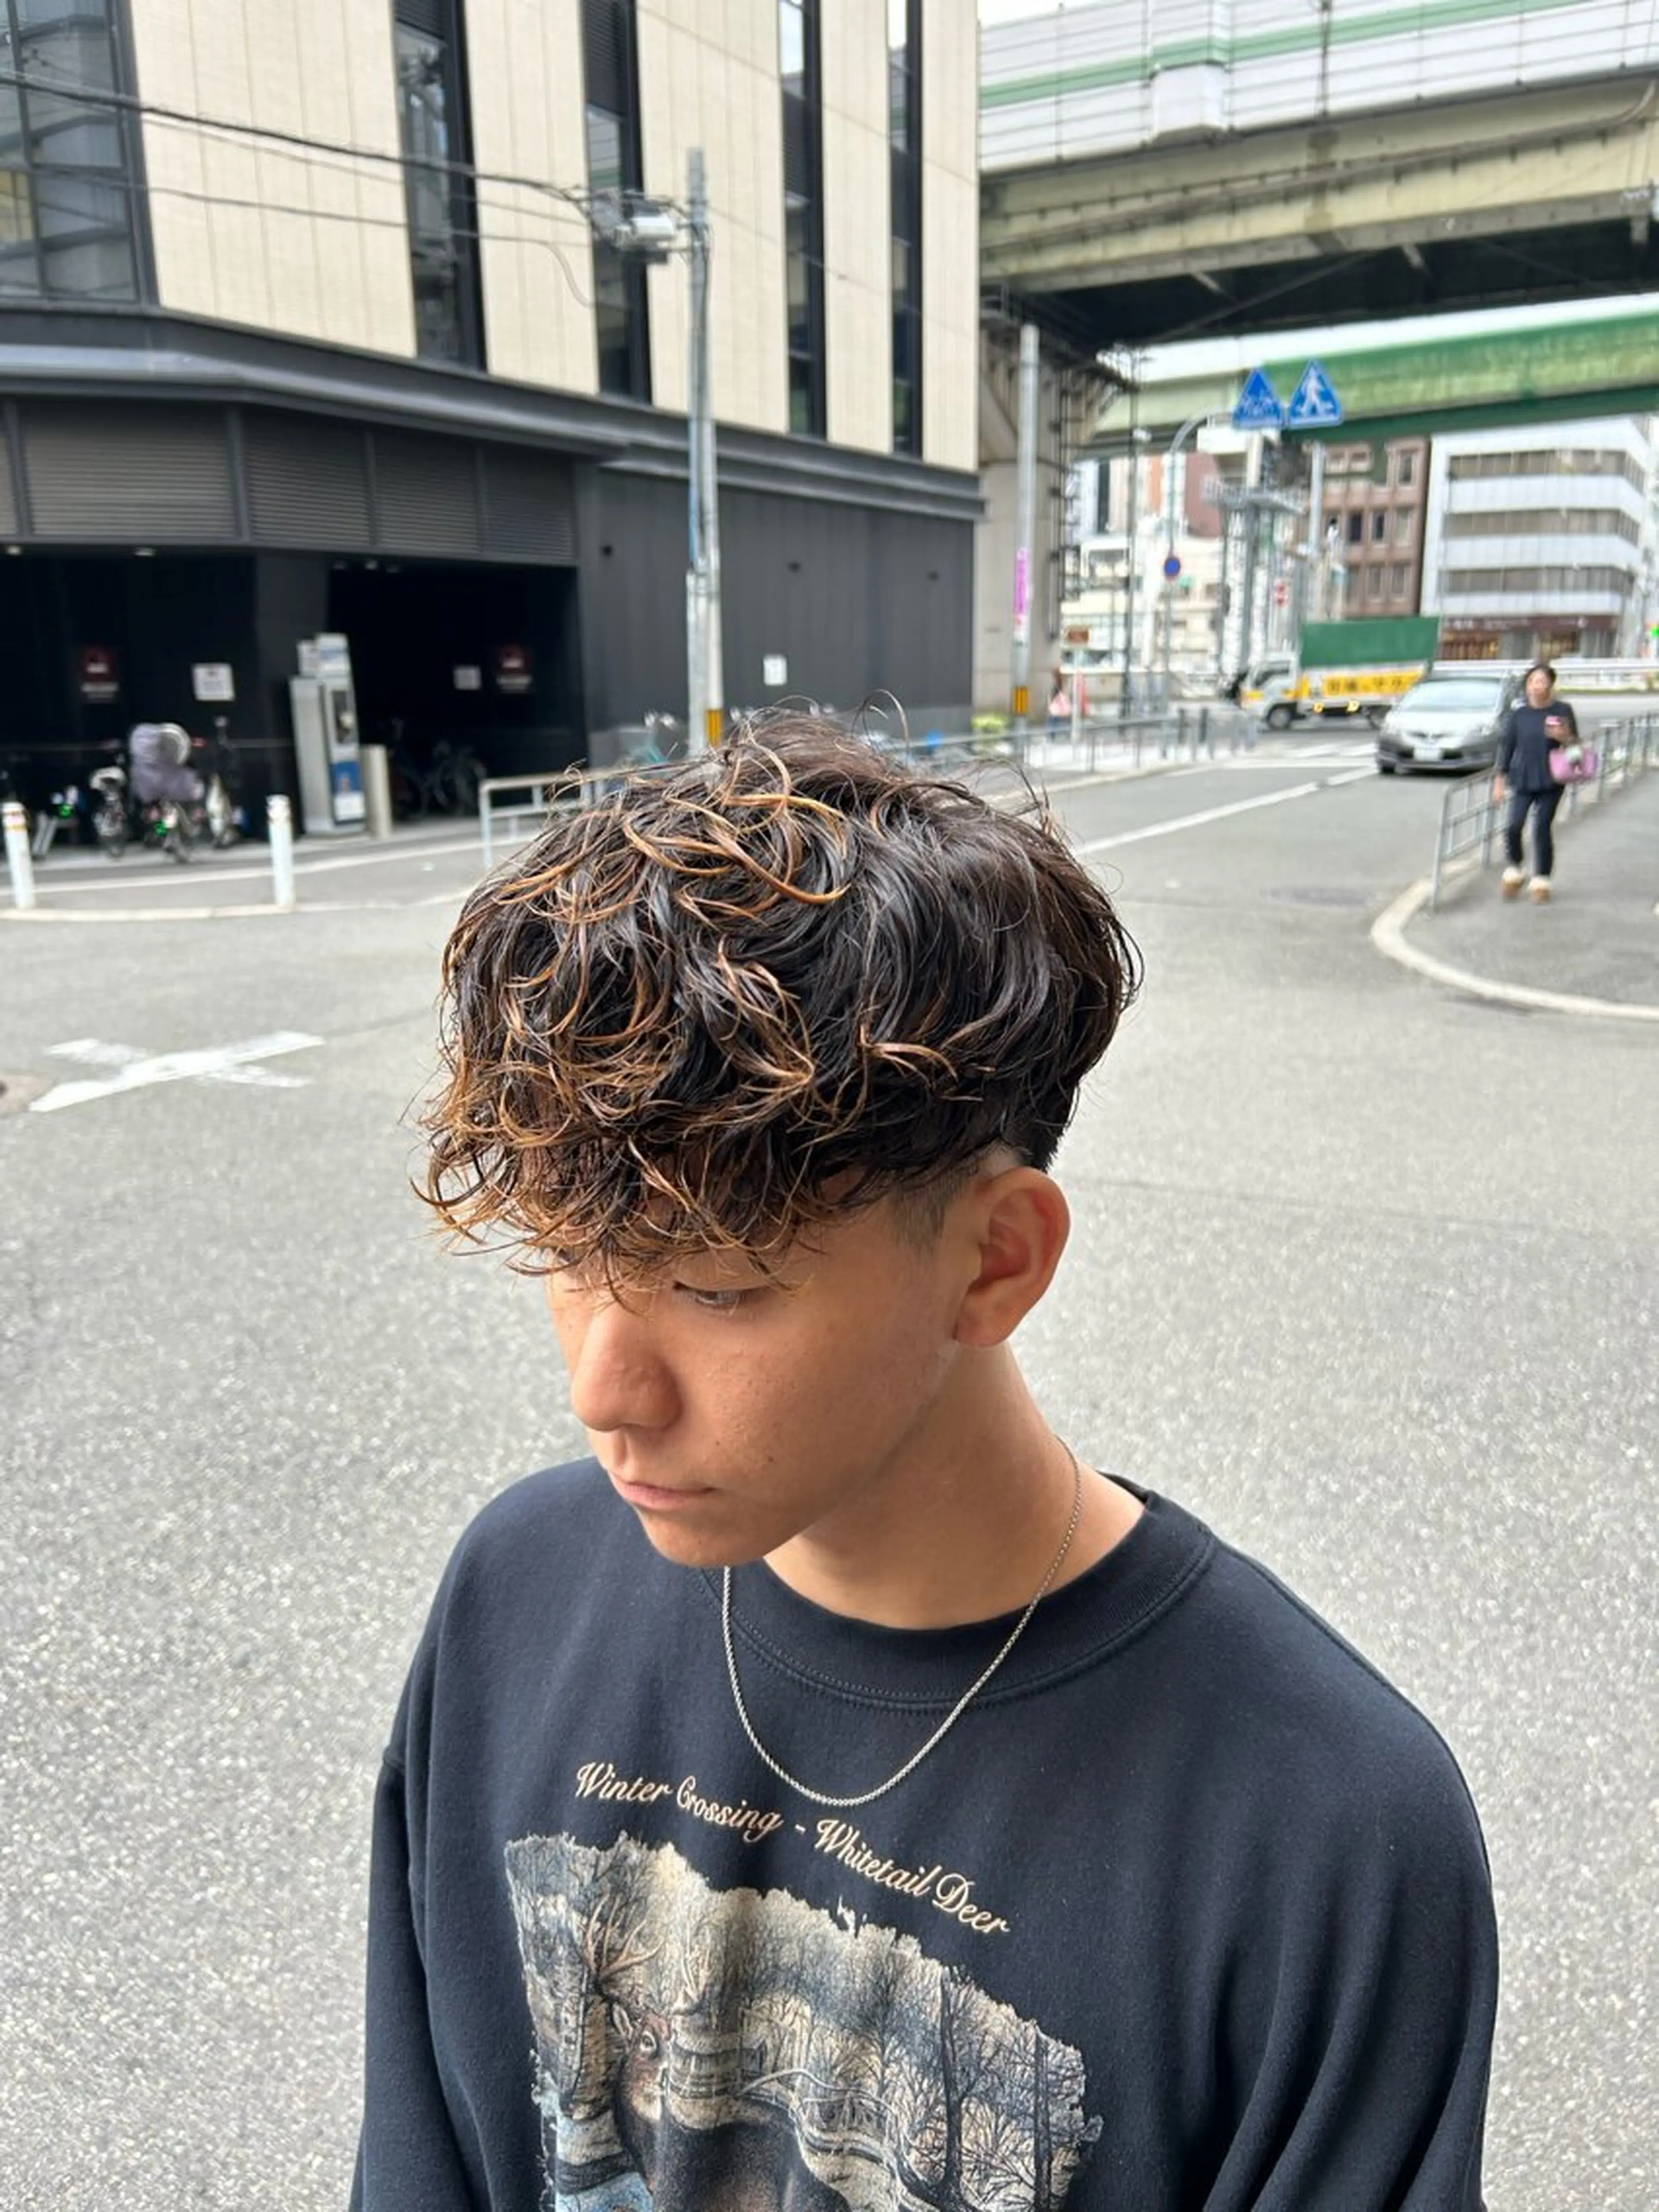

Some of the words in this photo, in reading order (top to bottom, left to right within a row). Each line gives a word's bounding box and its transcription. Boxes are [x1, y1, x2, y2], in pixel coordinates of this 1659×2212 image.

[575, 1761, 673, 1803] Winter
[676, 1775, 784, 1841] Crossing
[814, 1819, 942, 1897] Whitetail
[931, 1873, 1010, 1934] Deer
